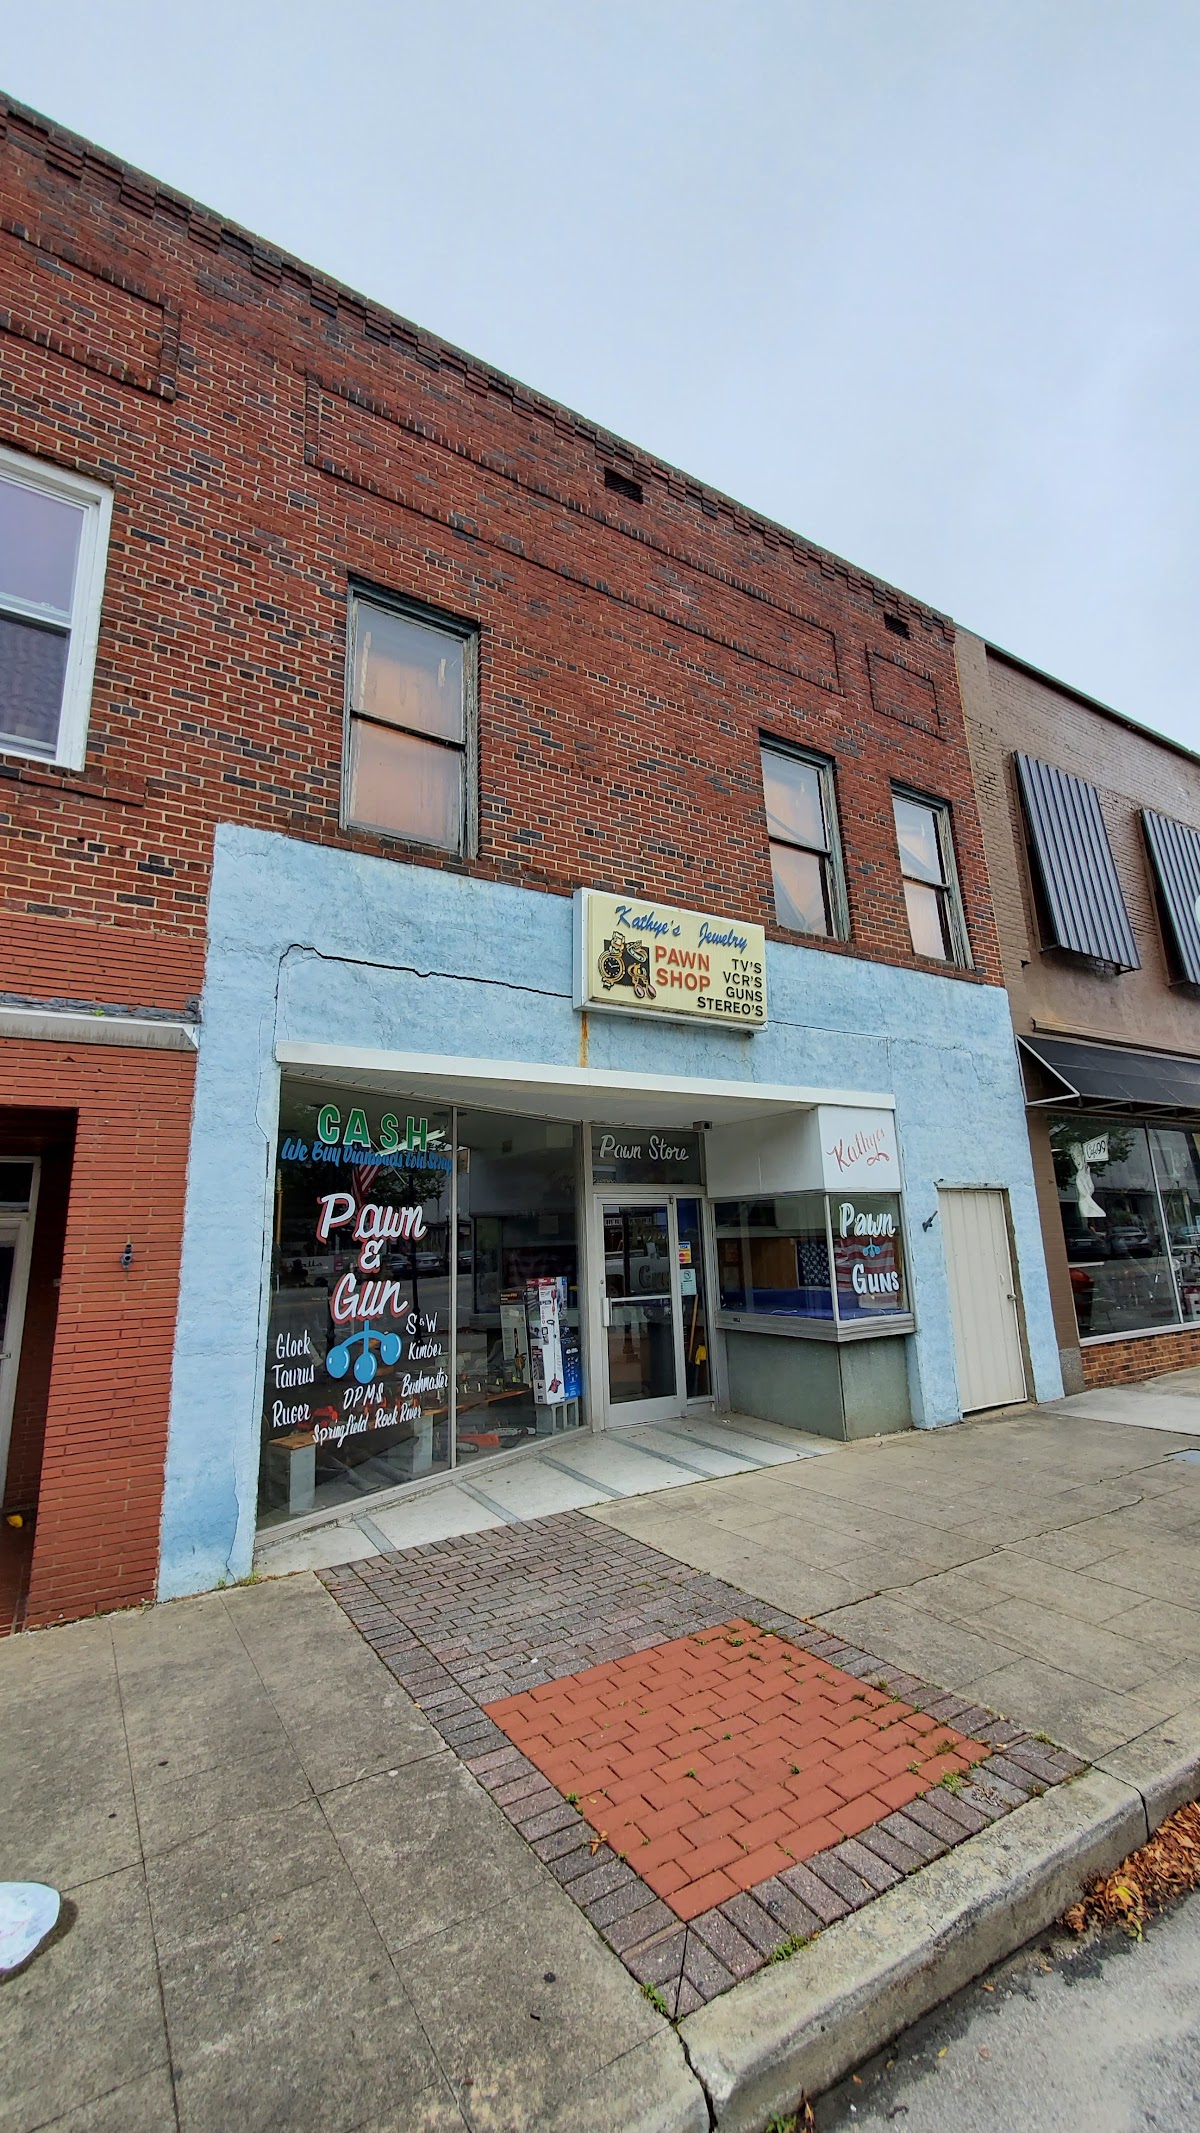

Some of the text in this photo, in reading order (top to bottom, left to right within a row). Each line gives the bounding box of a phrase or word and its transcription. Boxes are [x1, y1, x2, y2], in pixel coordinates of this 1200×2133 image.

[615, 905, 747, 953] Kathye's Jewelry
[655, 945, 710, 972] PAWN
[732, 959, 762, 974] TV'S
[655, 968, 711, 992] SHOP
[723, 972, 762, 988] VCR'S
[726, 987, 763, 1002] GUNS
[697, 997, 763, 1017] STEREO'S
[317, 1104, 428, 1151] CASH
[281, 1138, 308, 1162] We
[311, 1141, 341, 1167] Buy
[600, 1135, 689, 1161] Pawn Store
[316, 1193, 427, 1244] Pawn
[838, 1202, 896, 1239] Pawn
[358, 1239, 384, 1274] &
[331, 1273, 410, 1325] Gun
[276, 1330, 311, 1359] Glock
[408, 1338, 442, 1361] Kimber
[271, 1364, 315, 1389] Taurus
[400, 1367, 448, 1398] Bushmaster
[343, 1382, 384, 1411] DPMS
[312, 1402, 422, 1448] Springfield Rock River
